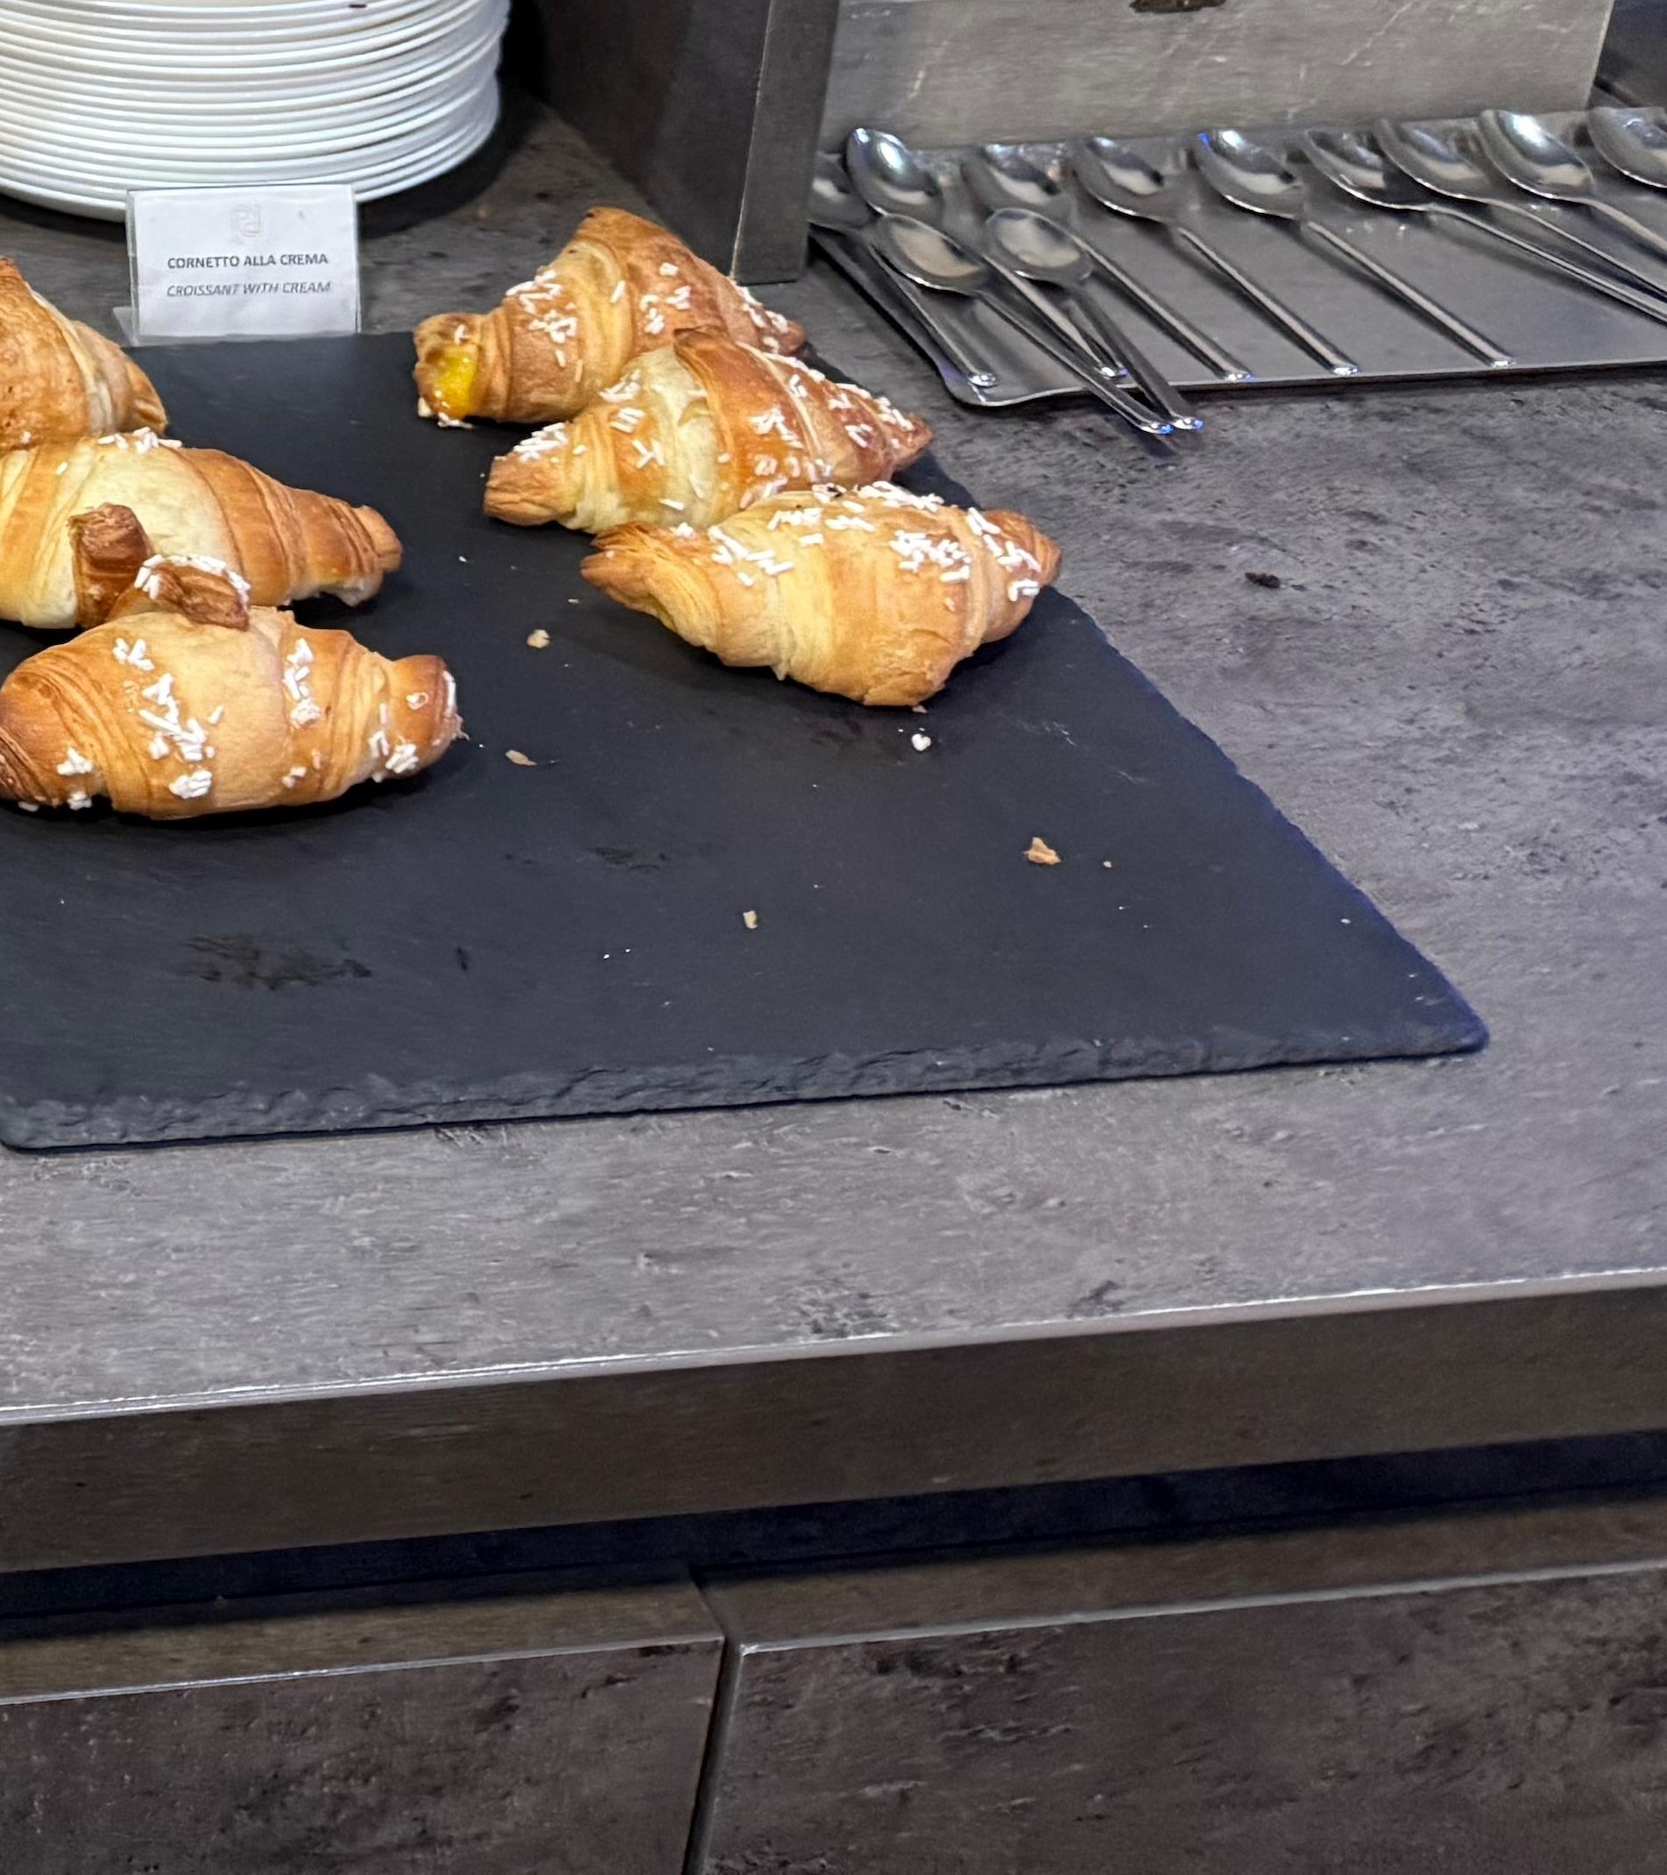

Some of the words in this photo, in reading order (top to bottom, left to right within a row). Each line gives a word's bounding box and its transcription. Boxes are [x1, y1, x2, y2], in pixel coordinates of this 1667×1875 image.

[167, 255, 240, 269] CORNETTO
[243, 254, 277, 267] ALLA
[280, 253, 329, 266] CREMA
[167, 283, 241, 297] CROISSANT
[243, 282, 279, 295] WITH
[282, 281, 331, 294] CREAM
